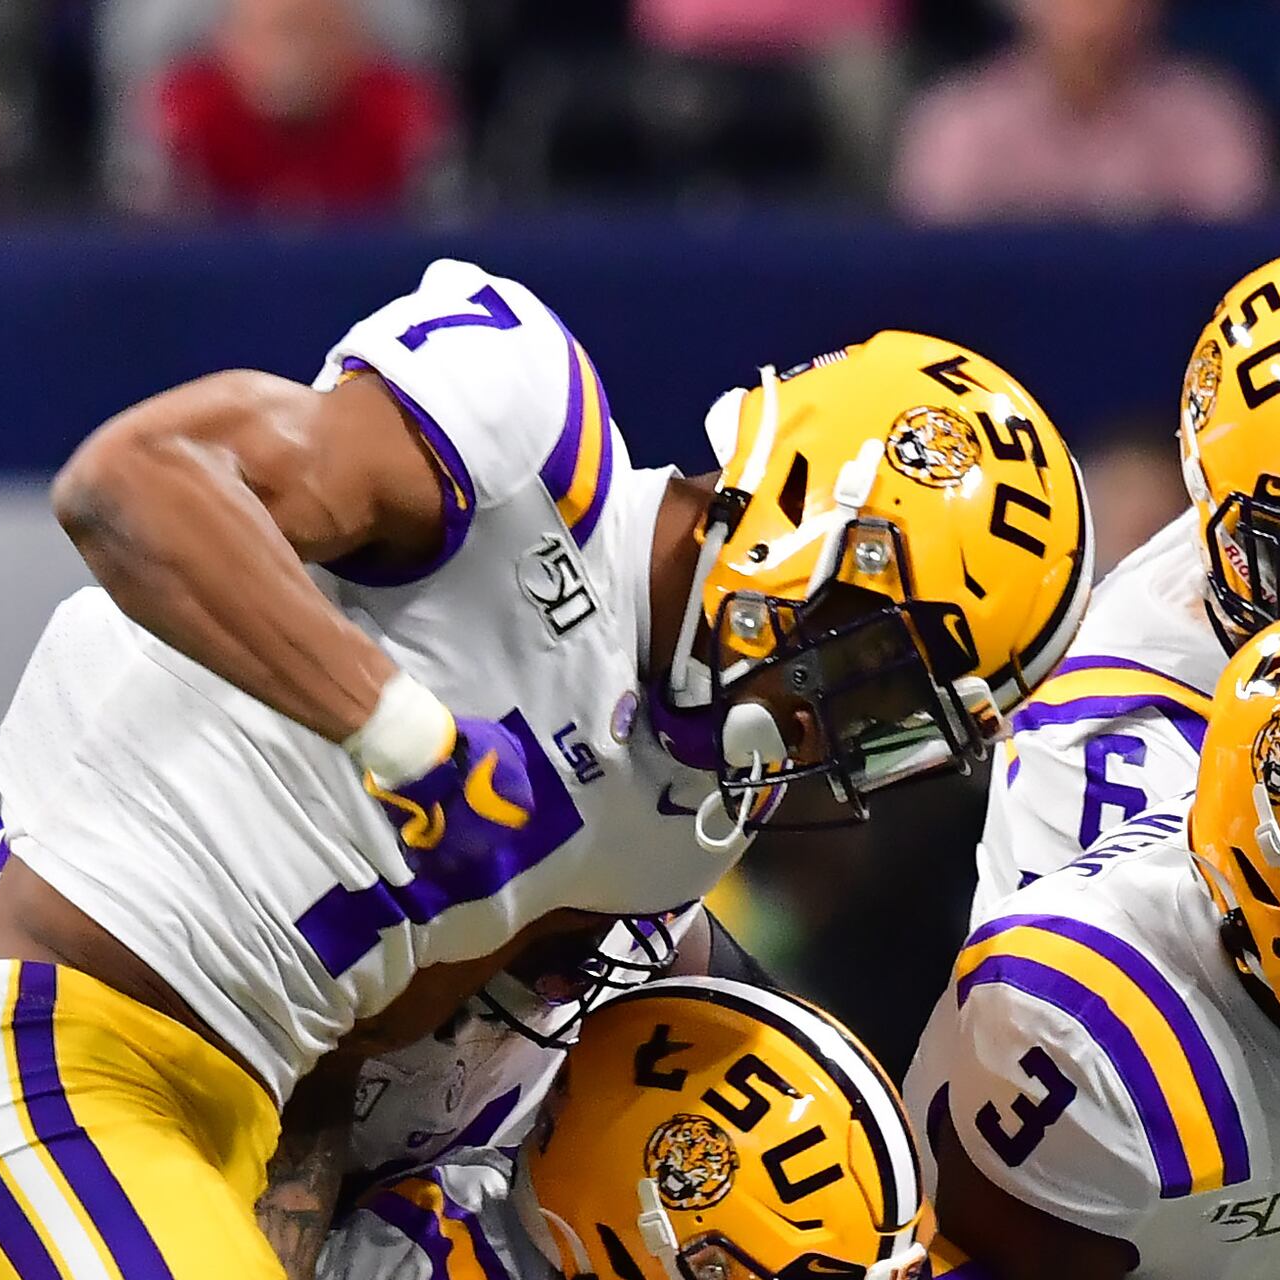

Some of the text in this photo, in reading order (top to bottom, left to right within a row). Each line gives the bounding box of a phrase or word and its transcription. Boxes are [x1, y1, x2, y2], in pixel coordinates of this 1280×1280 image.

[397, 285, 522, 352] 7
[920, 355, 1052, 559] LSU
[553, 721, 606, 785] LSU
[634, 1023, 845, 1205] LSU
[975, 1046, 1077, 1167] 3
